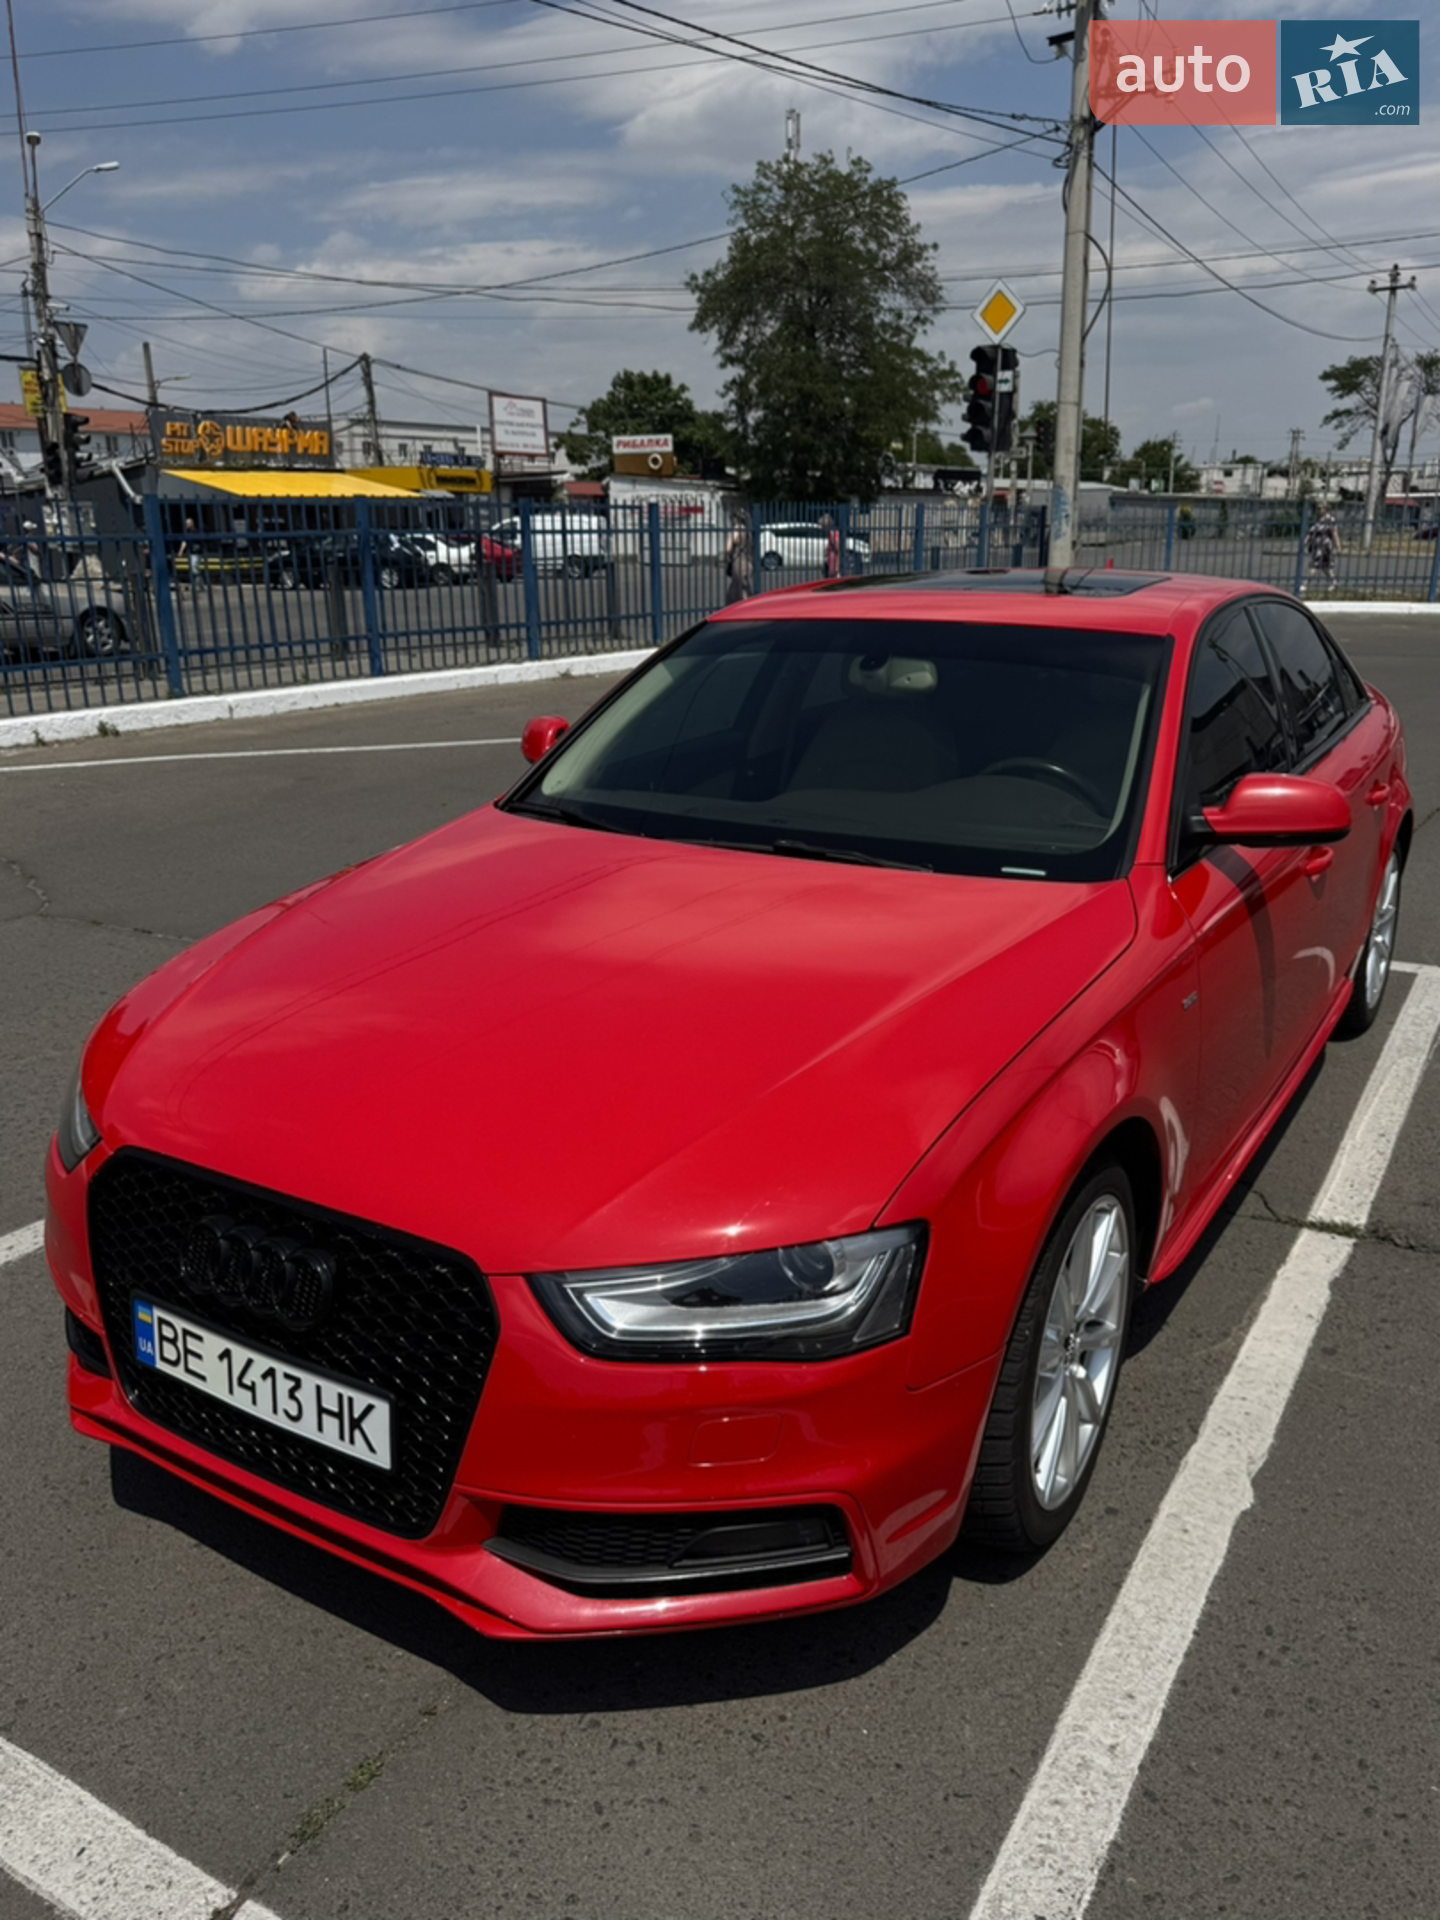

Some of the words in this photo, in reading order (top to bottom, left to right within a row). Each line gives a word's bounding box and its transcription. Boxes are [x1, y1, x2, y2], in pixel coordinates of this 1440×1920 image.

[166, 421, 190, 437] PIT
[161, 438, 200, 455] STOP
[226, 425, 329, 456] ШАУРМА
[616, 438, 670, 449] РИБАЛКА
[138, 1337, 154, 1356] UA
[157, 1316, 207, 1383] BE
[217, 1347, 303, 1423] 1413
[316, 1384, 377, 1455] HK
